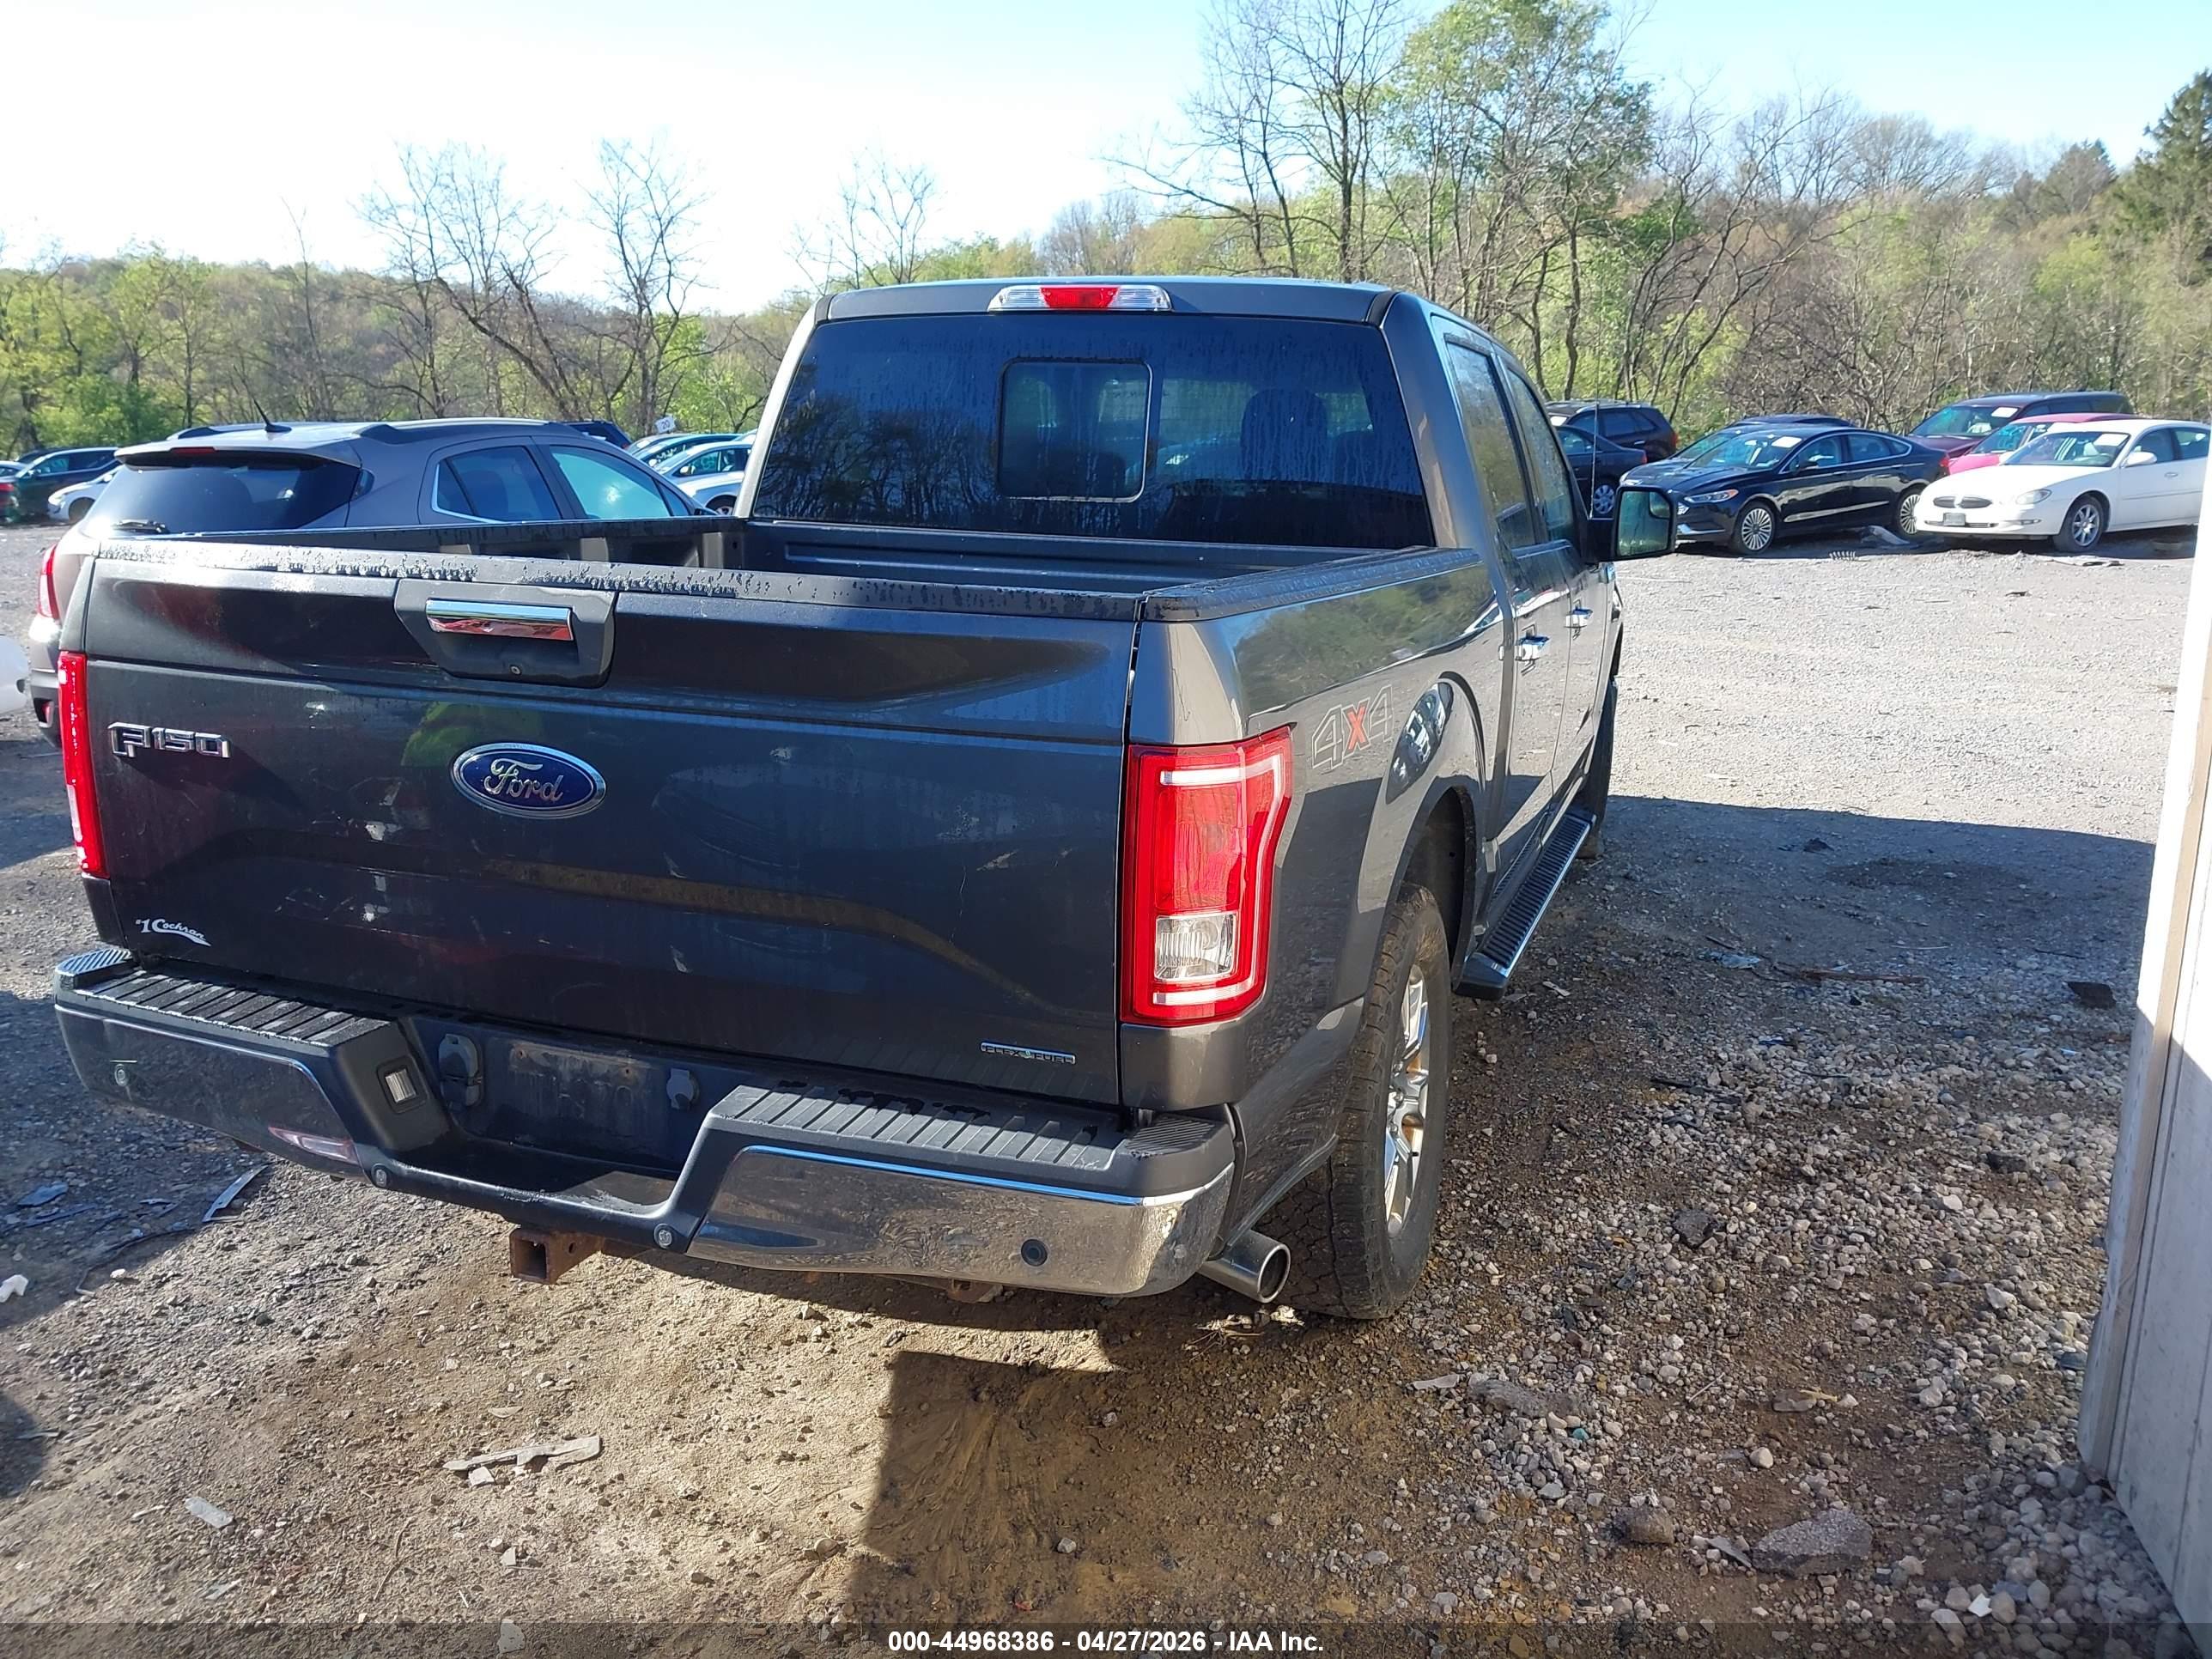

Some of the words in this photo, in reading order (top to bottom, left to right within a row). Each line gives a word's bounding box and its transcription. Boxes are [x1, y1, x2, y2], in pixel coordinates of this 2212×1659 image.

[483, 757, 564, 802] Ford
[151, 918, 212, 947] Cochran
[984, 1043, 1019, 1057] FLEX
[1033, 1051, 1074, 1065] FUEL
